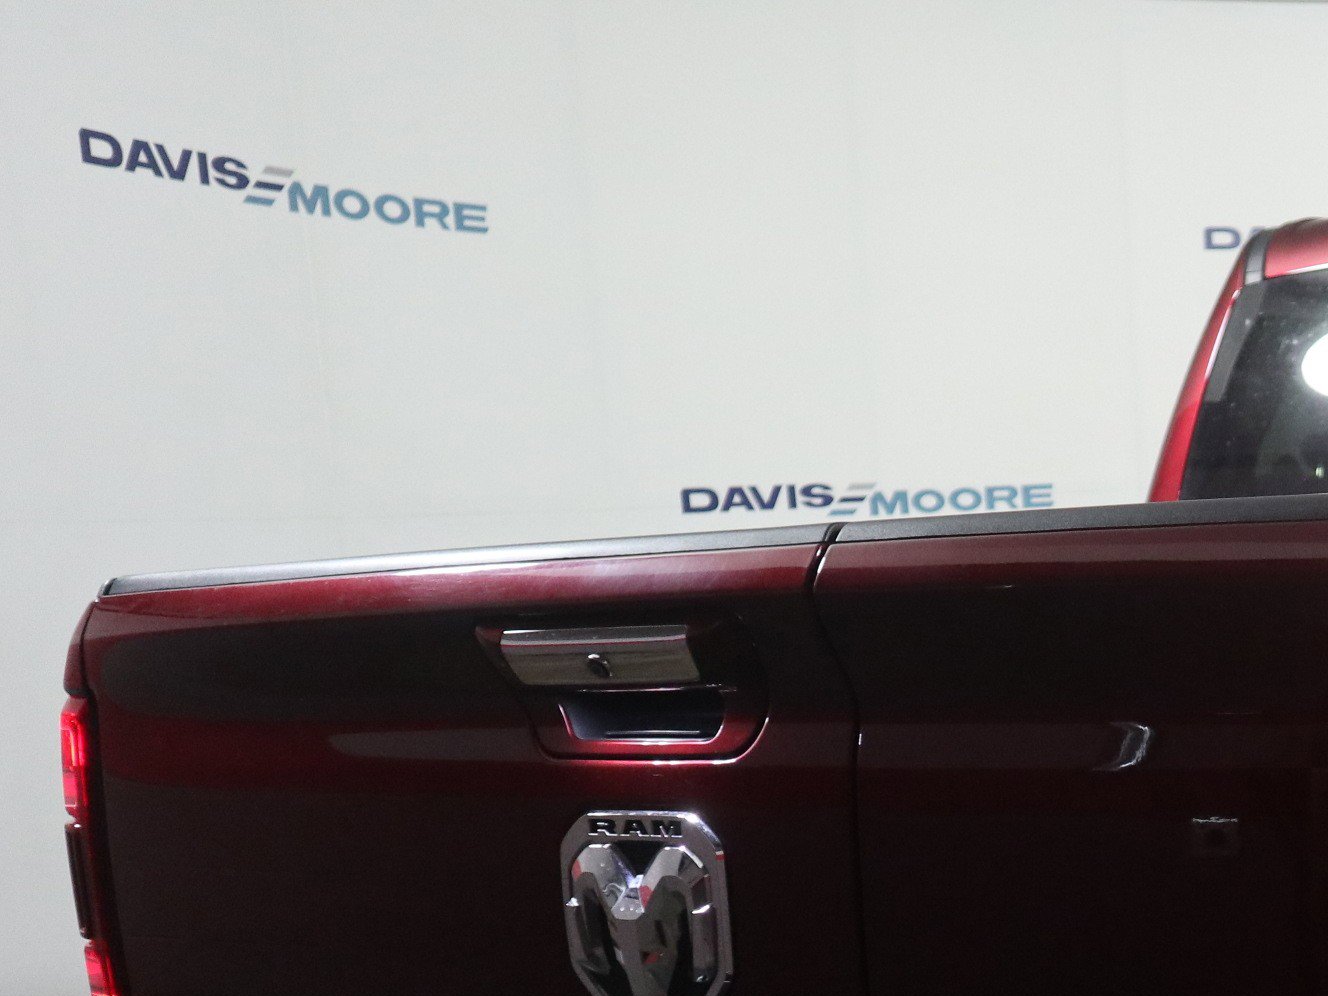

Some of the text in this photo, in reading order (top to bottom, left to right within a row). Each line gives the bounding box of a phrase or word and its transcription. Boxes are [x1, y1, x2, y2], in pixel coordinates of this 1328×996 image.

[79, 128, 489, 234] DAVIS MOORE
[680, 483, 1054, 516] DAVIS MOORE
[588, 818, 683, 838] RAM
